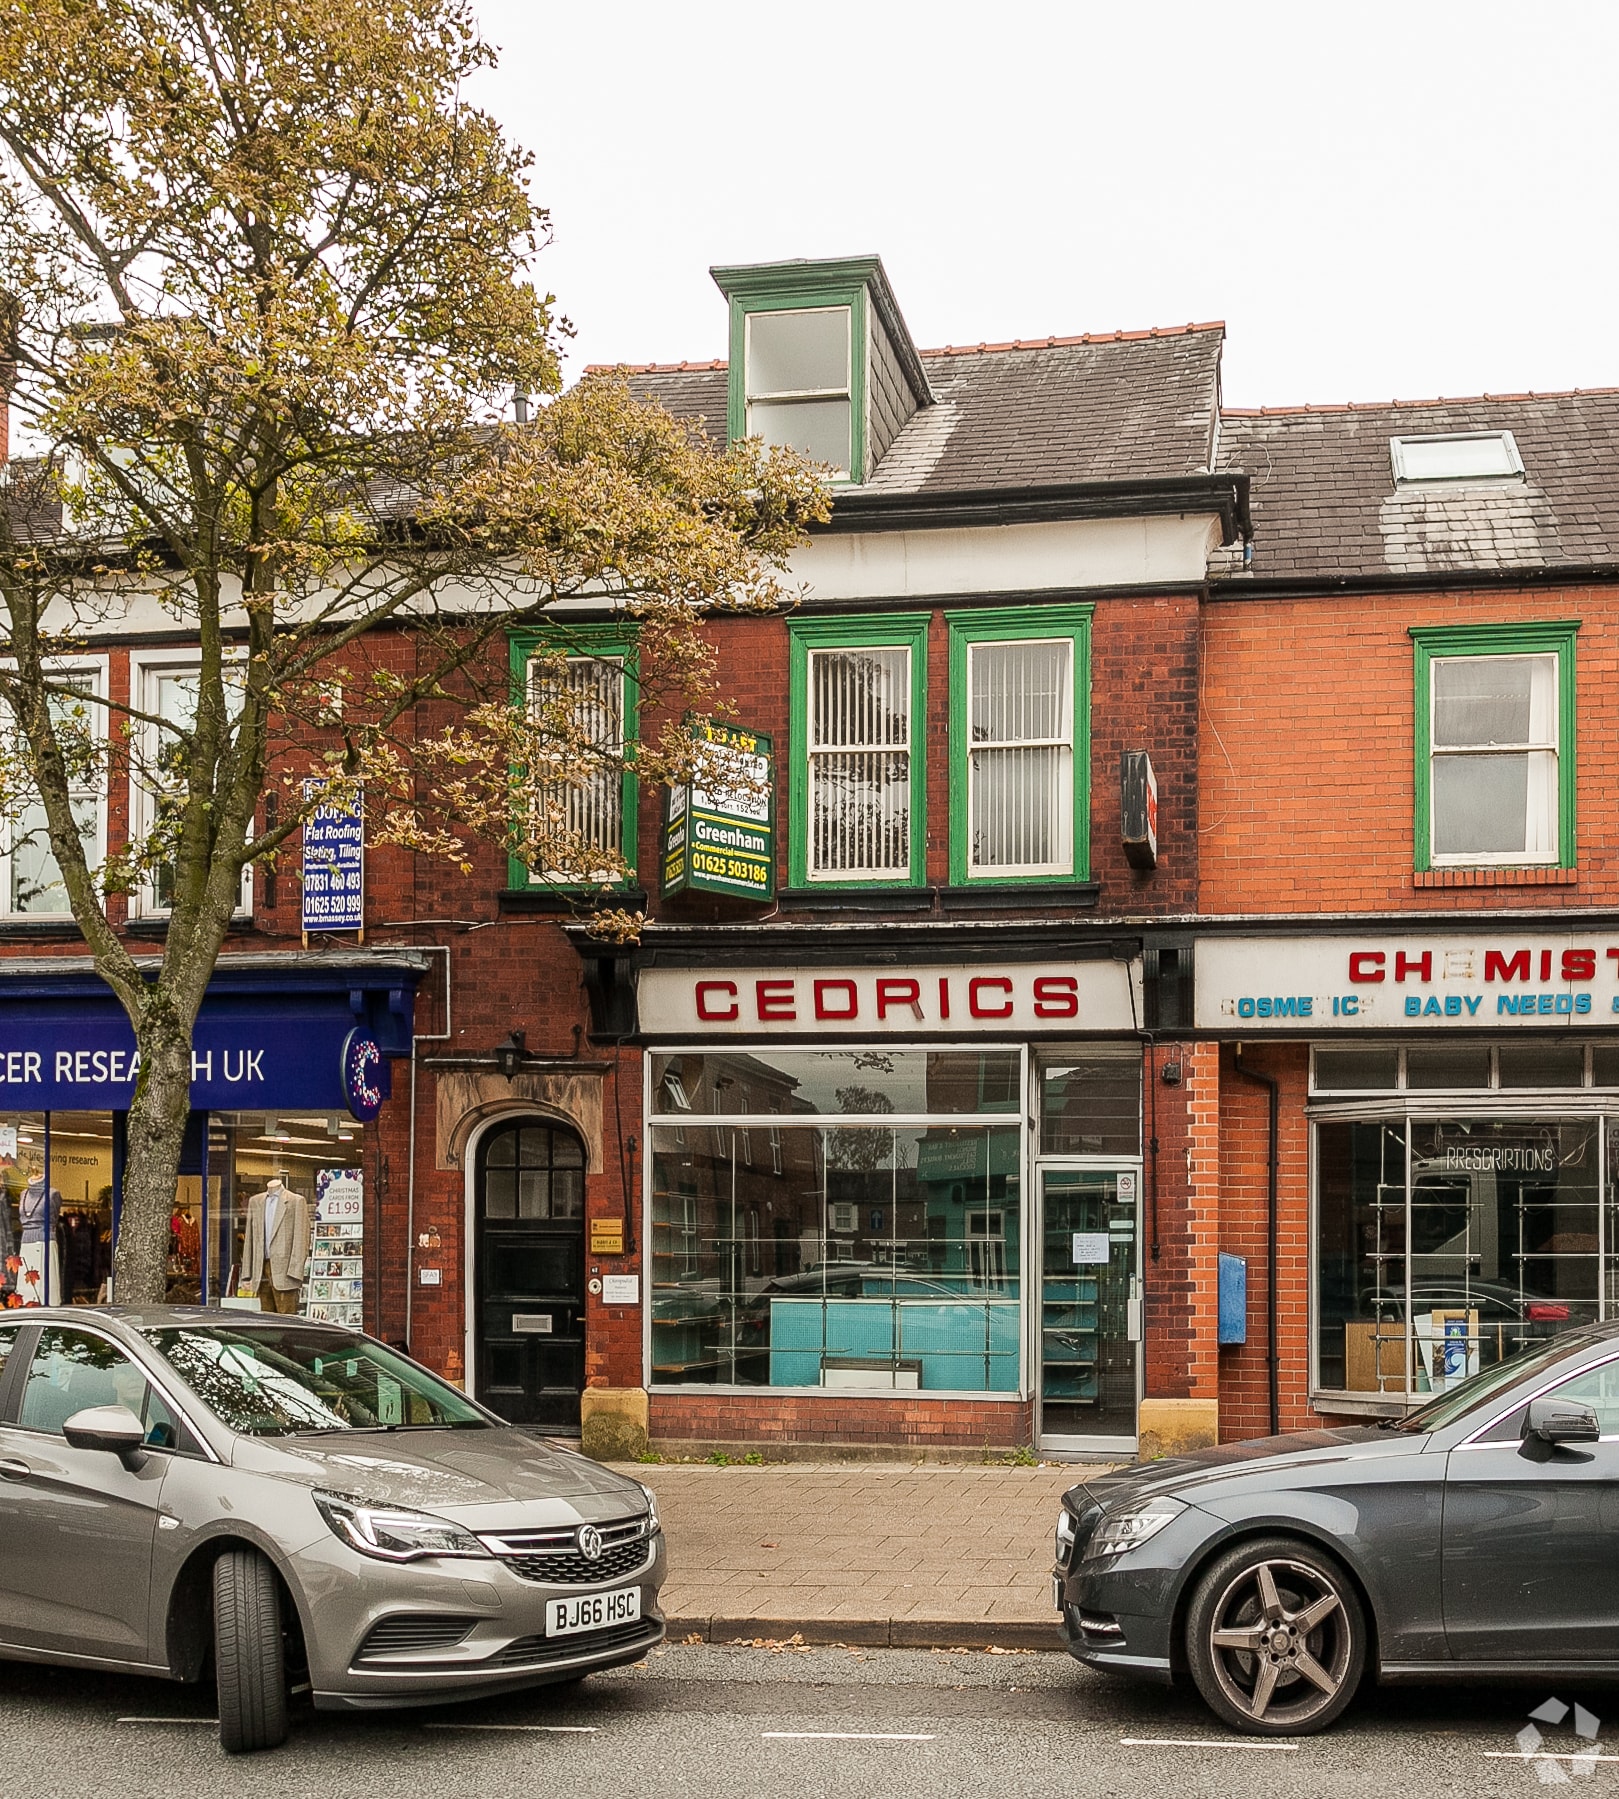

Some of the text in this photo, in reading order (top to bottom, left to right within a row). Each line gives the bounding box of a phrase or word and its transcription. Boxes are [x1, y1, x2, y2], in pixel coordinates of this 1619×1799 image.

[305, 824, 361, 841] Flat Roofing
[695, 821, 765, 851] Greenham
[339, 843, 361, 861] Tiling
[695, 841, 734, 856] Commercial
[692, 855, 726, 876] 01625
[728, 861, 767, 883] 503186
[305, 873, 329, 892] 07831
[346, 872, 361, 890] 493
[305, 894, 361, 914] 01625 520 999
[304, 914, 362, 924] www.bmassey.co.uk
[695, 976, 1079, 1021] CEDRICS
[1404, 995, 1483, 1017] BABY
[1497, 993, 1591, 1015] NEEDS
[55, 1050, 212, 1083] RESEAH
[223, 1050, 265, 1082] UK
[29, 1151, 68, 1167] life-ving
[69, 1154, 99, 1167] research
[328, 1201, 359, 1214] £1.99
[556, 1598, 603, 1631] BJ66
